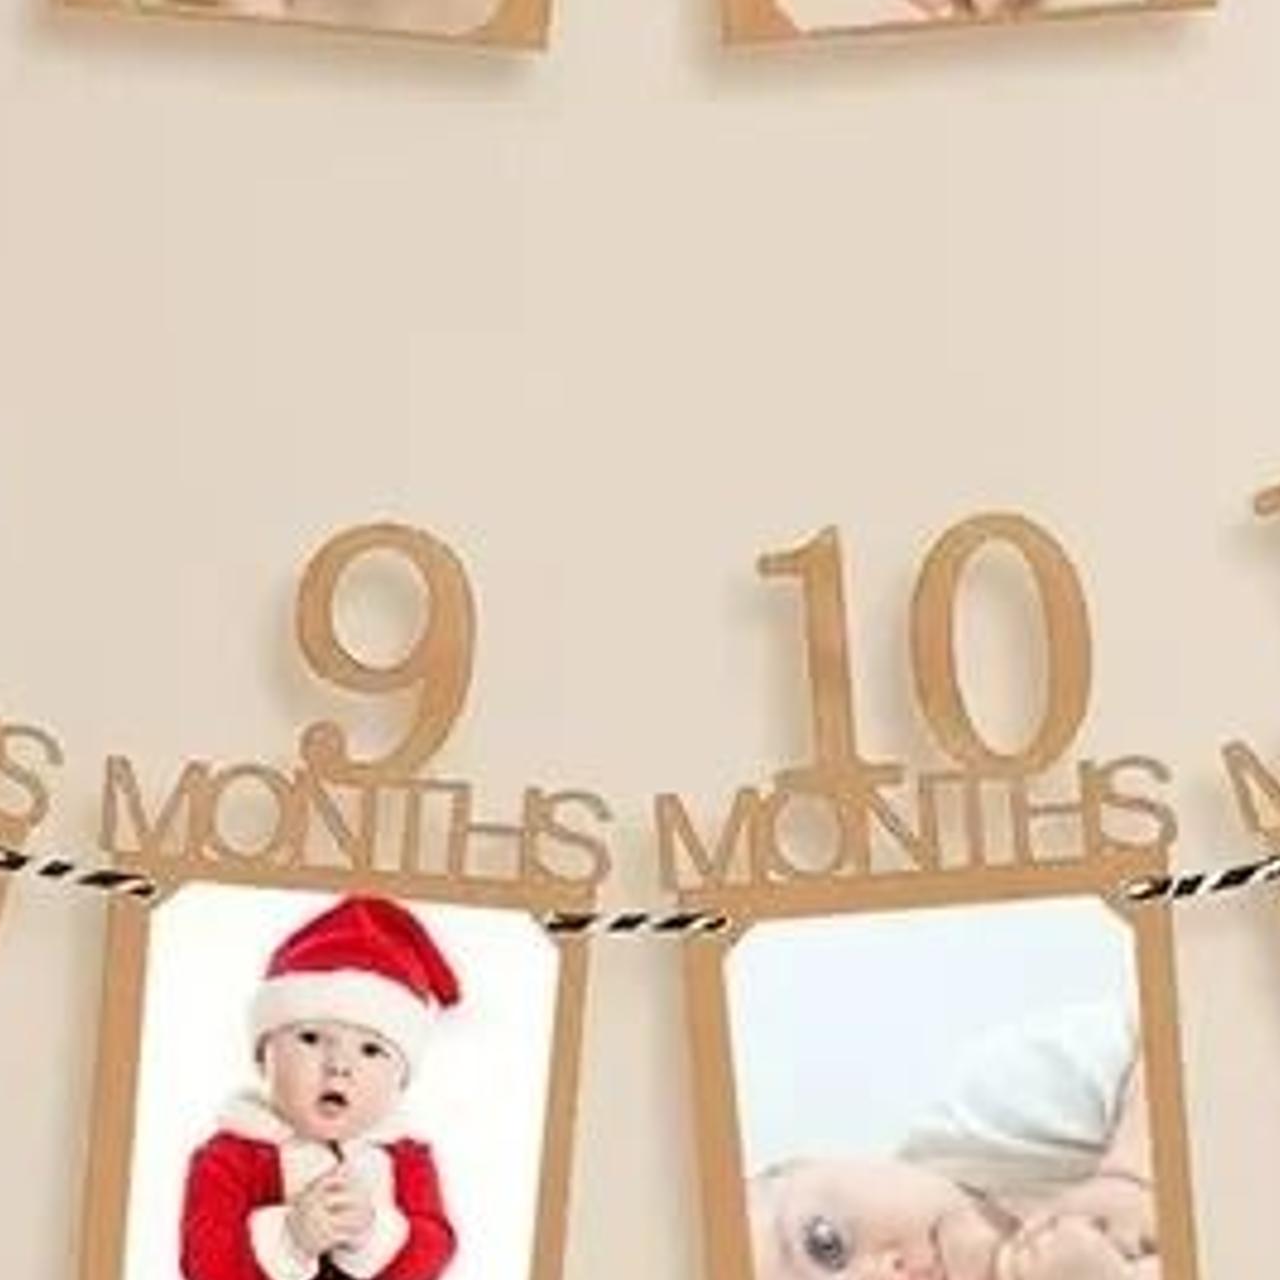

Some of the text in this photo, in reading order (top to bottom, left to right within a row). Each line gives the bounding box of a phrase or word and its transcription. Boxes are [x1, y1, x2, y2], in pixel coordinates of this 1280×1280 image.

[295, 521, 477, 781] 9
[757, 512, 1094, 783] 10
[100, 755, 612, 889] MONTHS
[654, 756, 1177, 891] MONTHS
